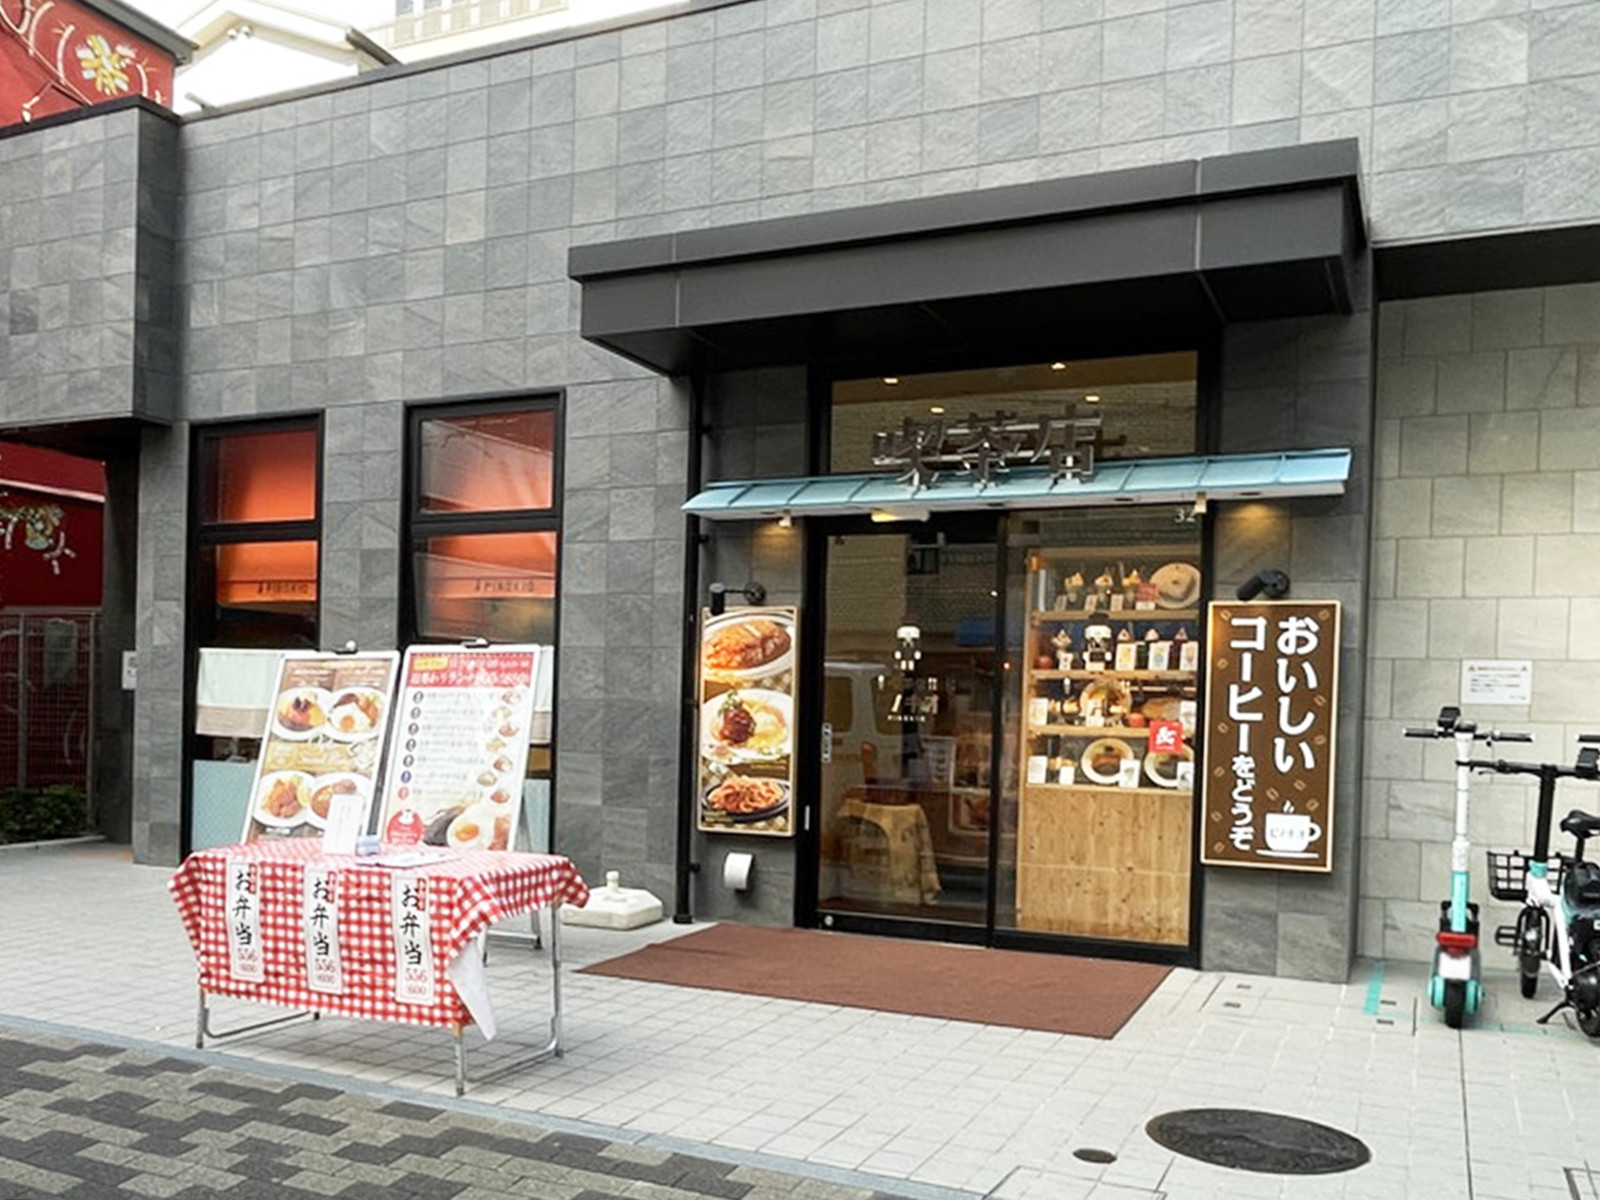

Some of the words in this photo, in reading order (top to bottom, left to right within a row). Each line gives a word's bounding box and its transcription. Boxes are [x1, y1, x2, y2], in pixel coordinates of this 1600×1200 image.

[873, 405, 1101, 490] 喫茶店
[1218, 616, 1268, 851] コーヒーをどうぞ
[1273, 616, 1320, 773] おいしい
[232, 869, 253, 946] お弁当
[309, 877, 330, 956] お弁当
[400, 885, 422, 965] お弁当
